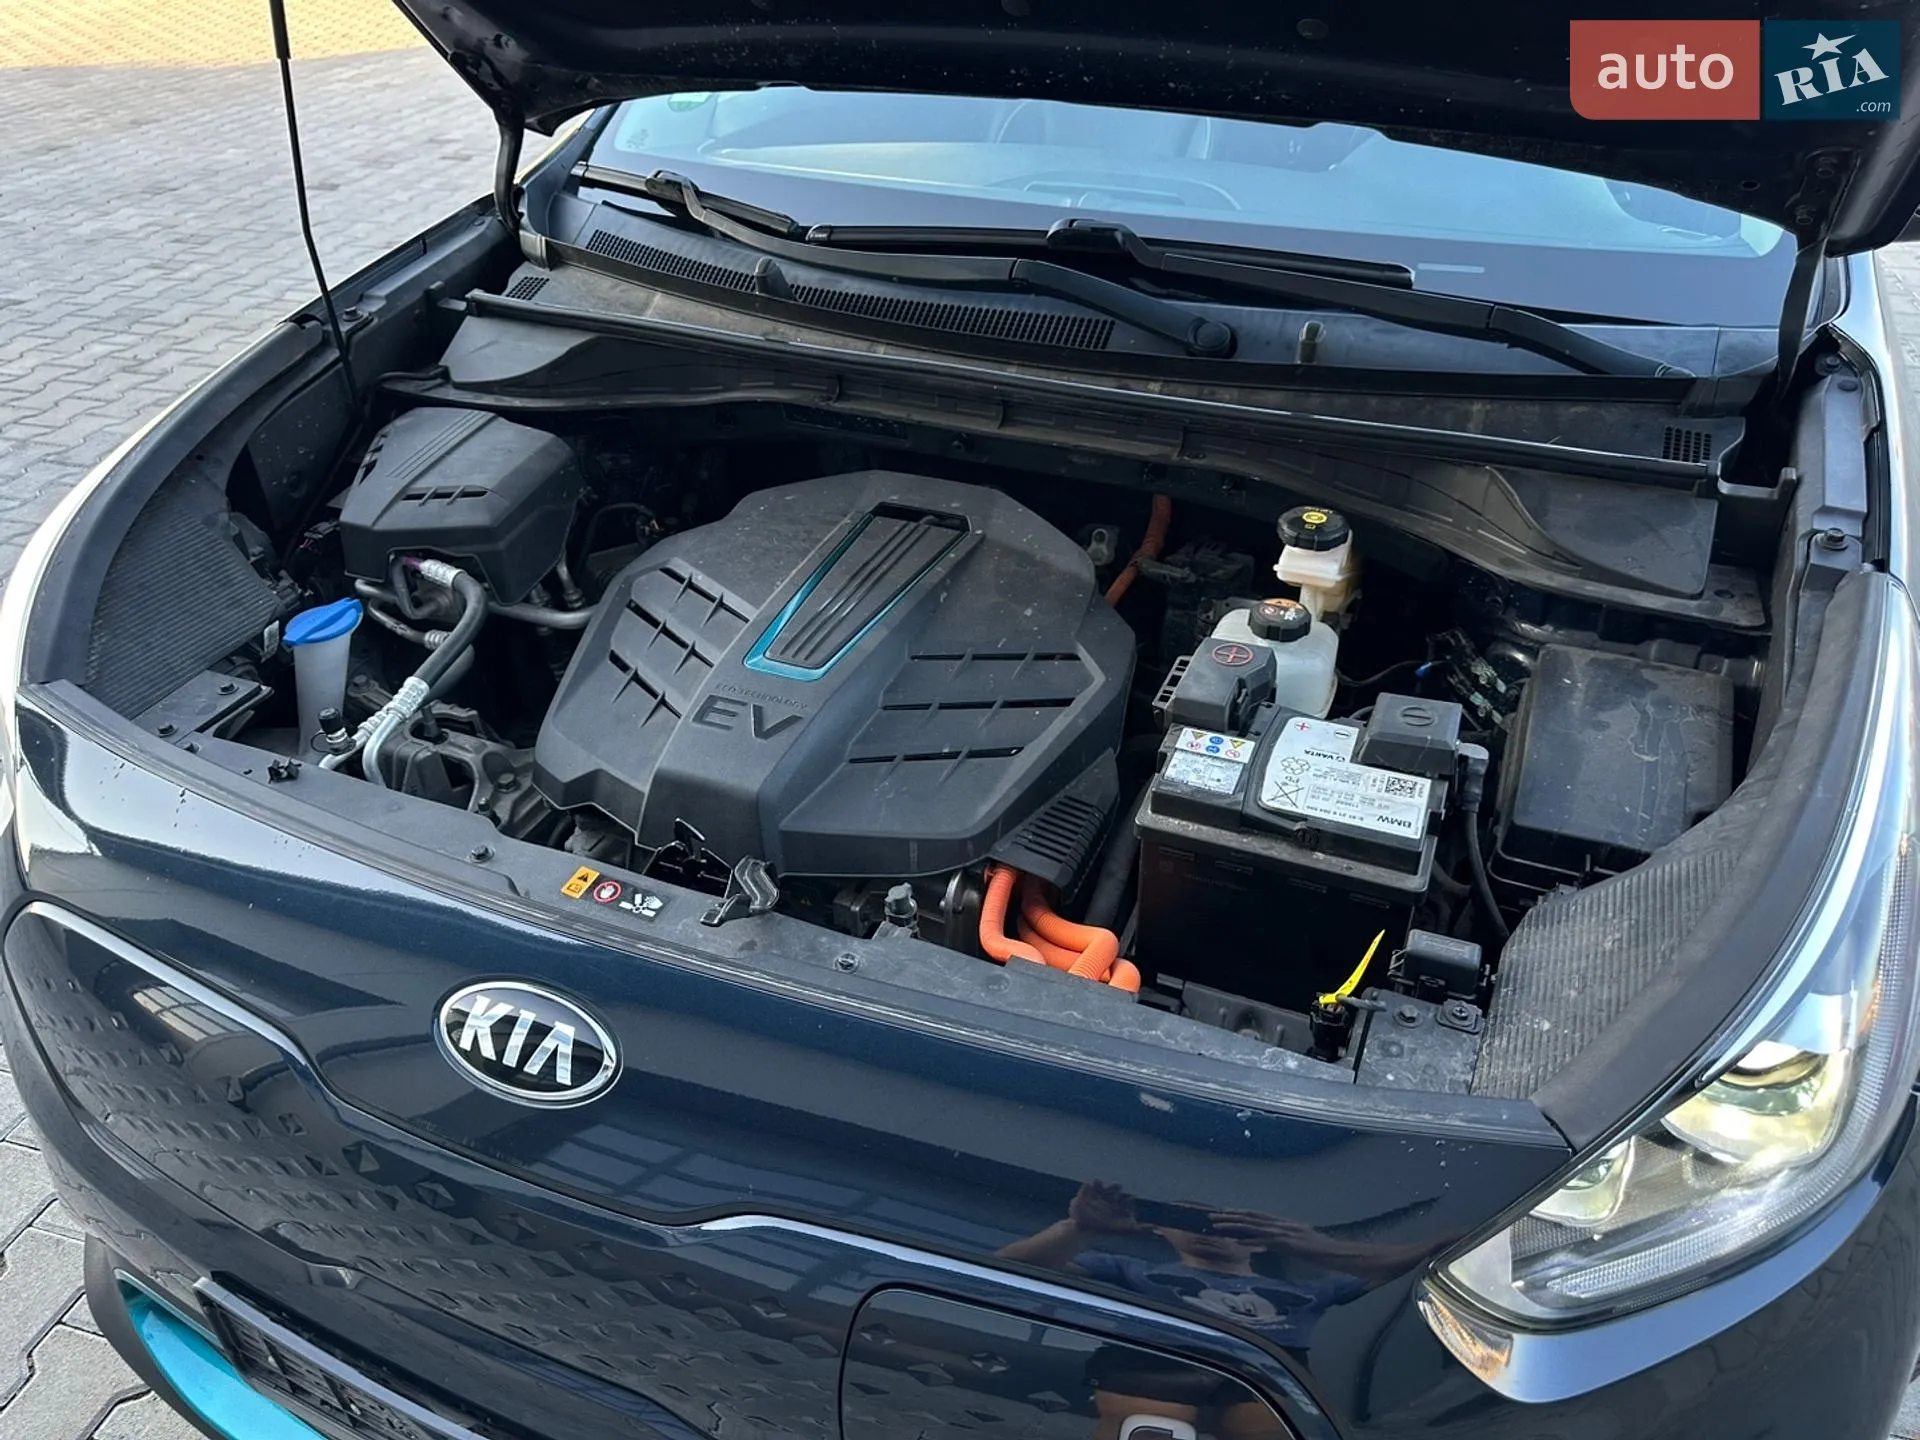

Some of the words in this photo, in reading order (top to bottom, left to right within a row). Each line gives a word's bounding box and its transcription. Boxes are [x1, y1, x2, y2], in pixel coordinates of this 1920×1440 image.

[690, 694, 804, 742] EV
[1304, 748, 1334, 760] VARTA
[1376, 815, 1412, 829] BMW
[458, 994, 576, 1087] KIA
